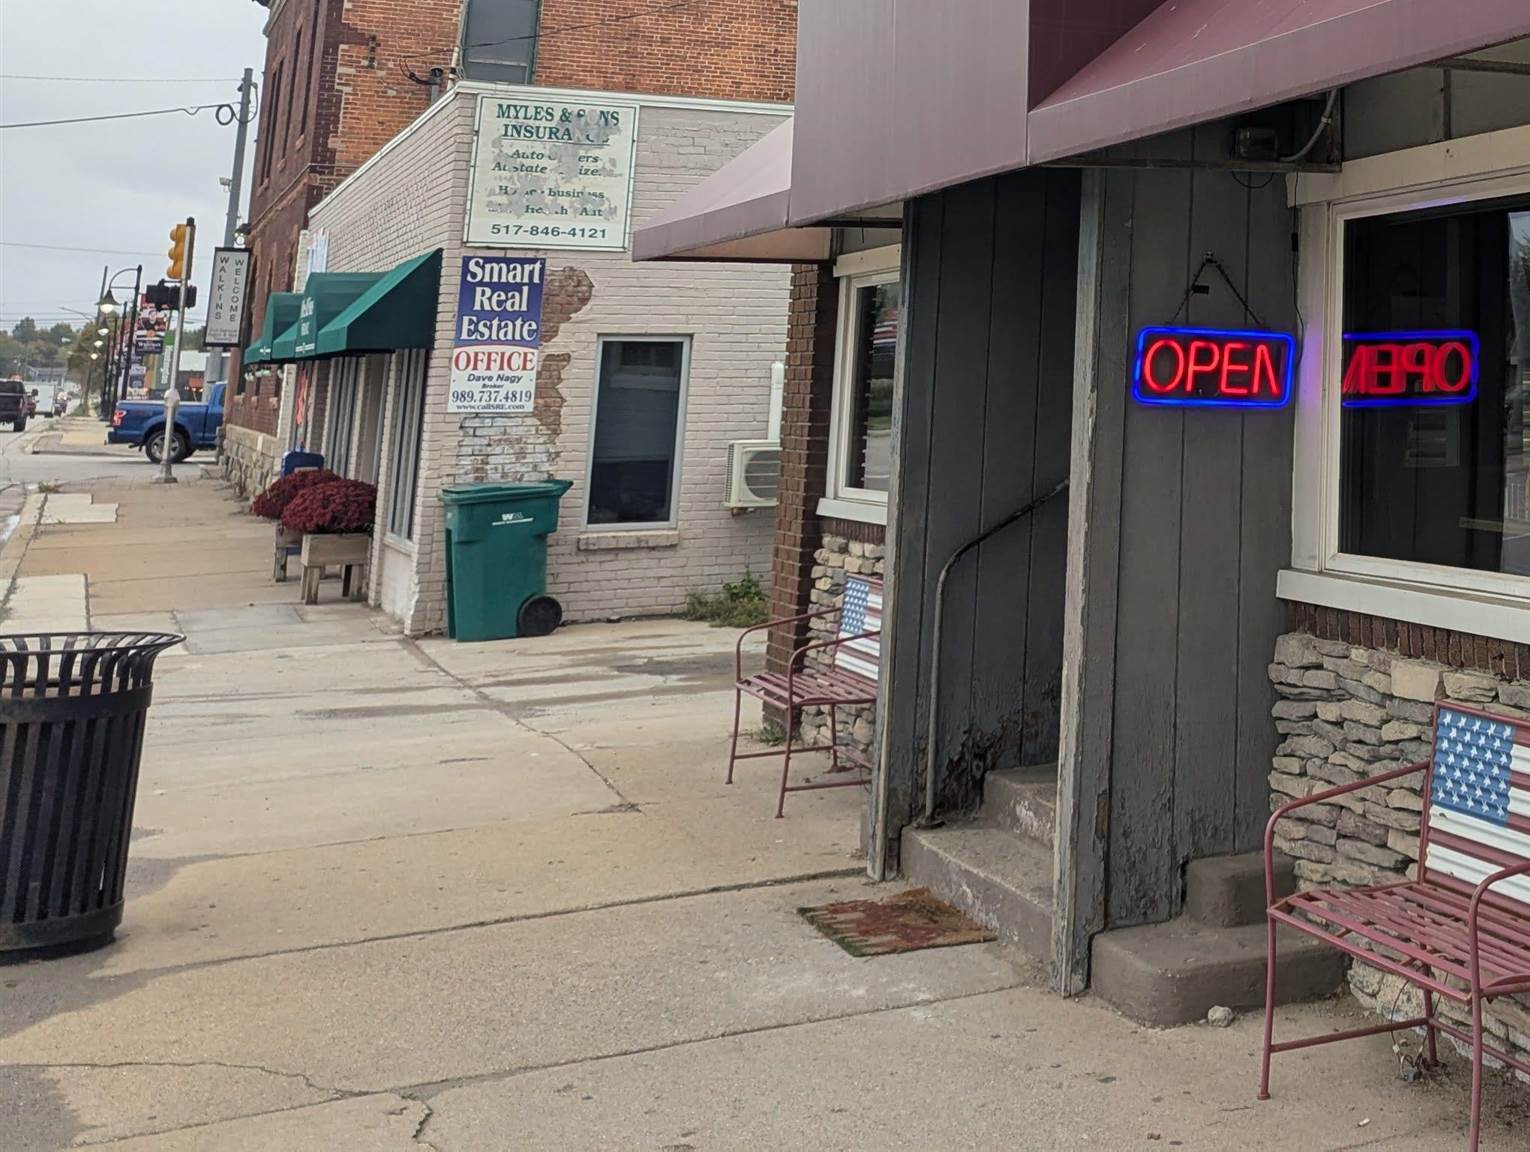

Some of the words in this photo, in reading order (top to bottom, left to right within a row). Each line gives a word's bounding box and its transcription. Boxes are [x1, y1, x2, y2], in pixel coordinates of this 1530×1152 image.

[496, 103, 554, 122] MYLES
[560, 107, 572, 123] &
[576, 108, 620, 127] SNS
[502, 124, 610, 143] INSURA
[548, 187, 605, 199] businss
[490, 223, 607, 239] 517-846-4121
[466, 258, 543, 284] Smart
[229, 259, 244, 322] WELCOME
[473, 286, 528, 311] Real
[460, 315, 538, 341] Estate
[454, 351, 536, 372] OFFICE
[1142, 338, 1282, 396] OPEN
[467, 373, 494, 382] Dave
[495, 373, 523, 384] Nagy
[451, 390, 532, 403] 989.737.4819
